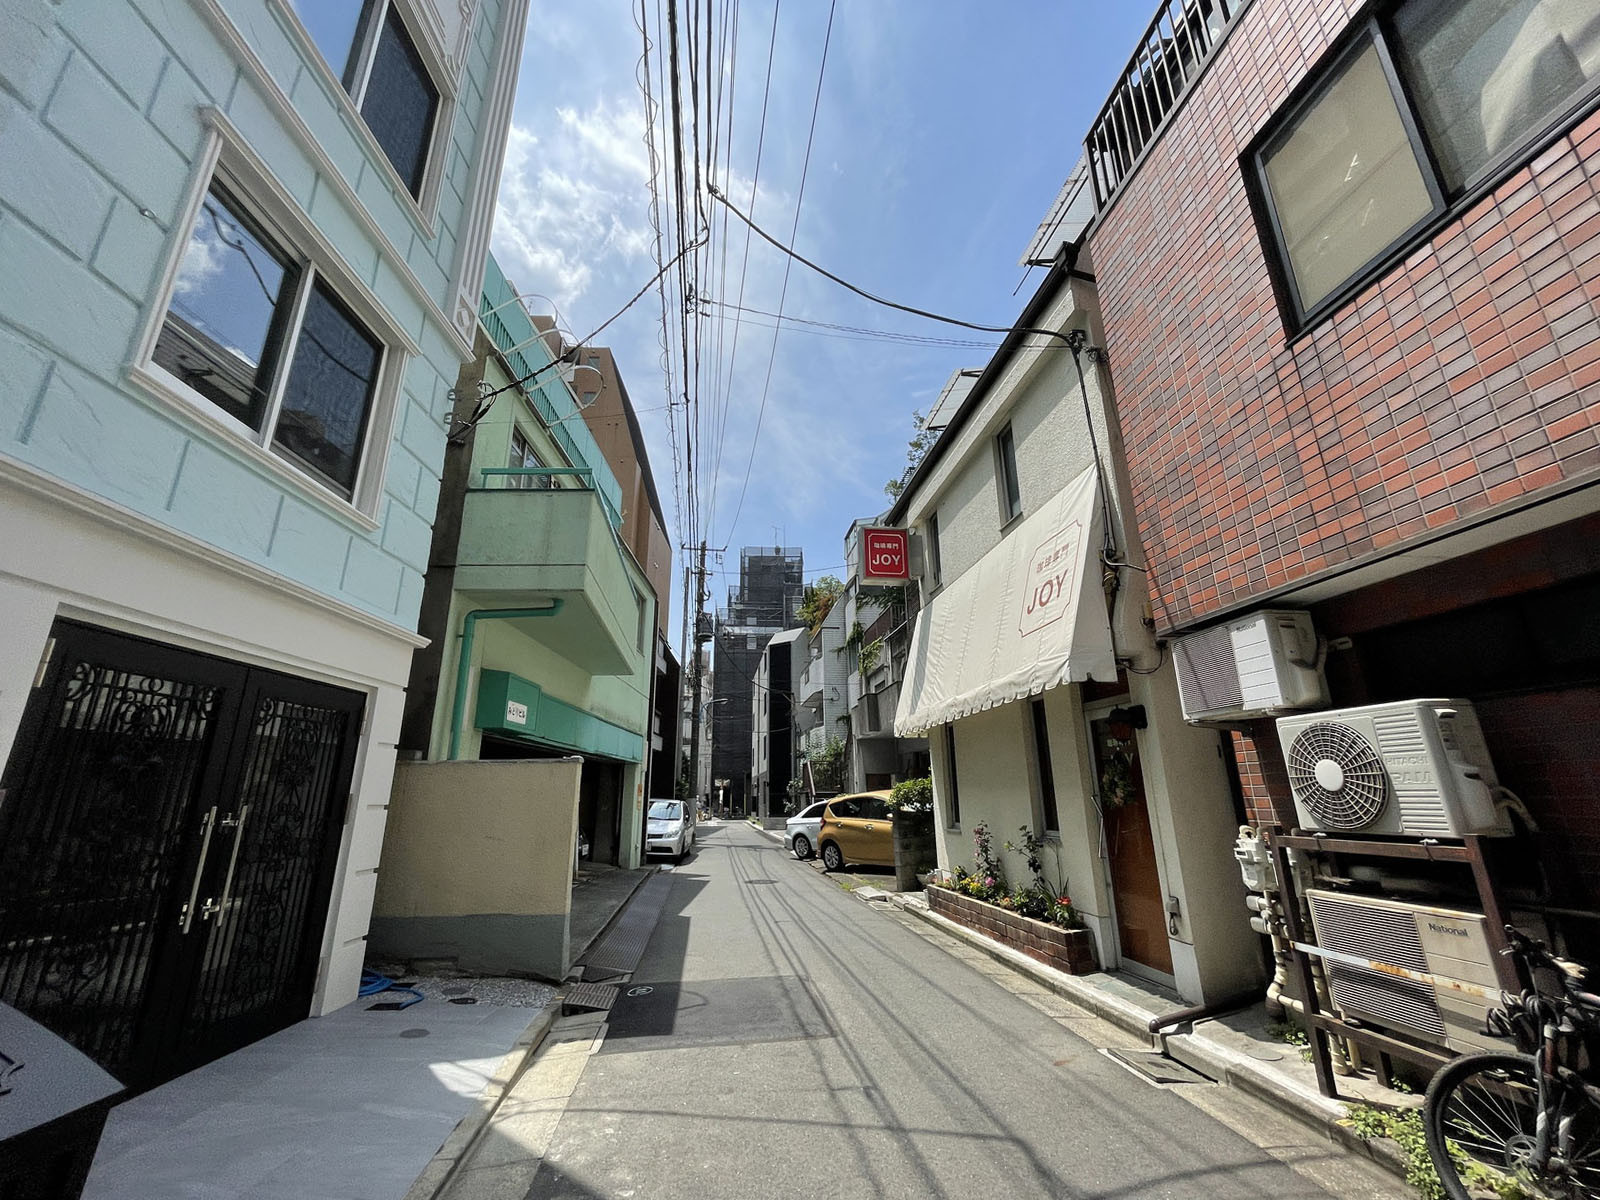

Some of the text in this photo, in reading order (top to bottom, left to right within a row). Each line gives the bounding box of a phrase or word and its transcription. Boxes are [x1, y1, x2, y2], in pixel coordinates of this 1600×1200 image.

[872, 553, 901, 566] JOY
[1026, 568, 1069, 615] JOY
[1428, 922, 1469, 937] National
